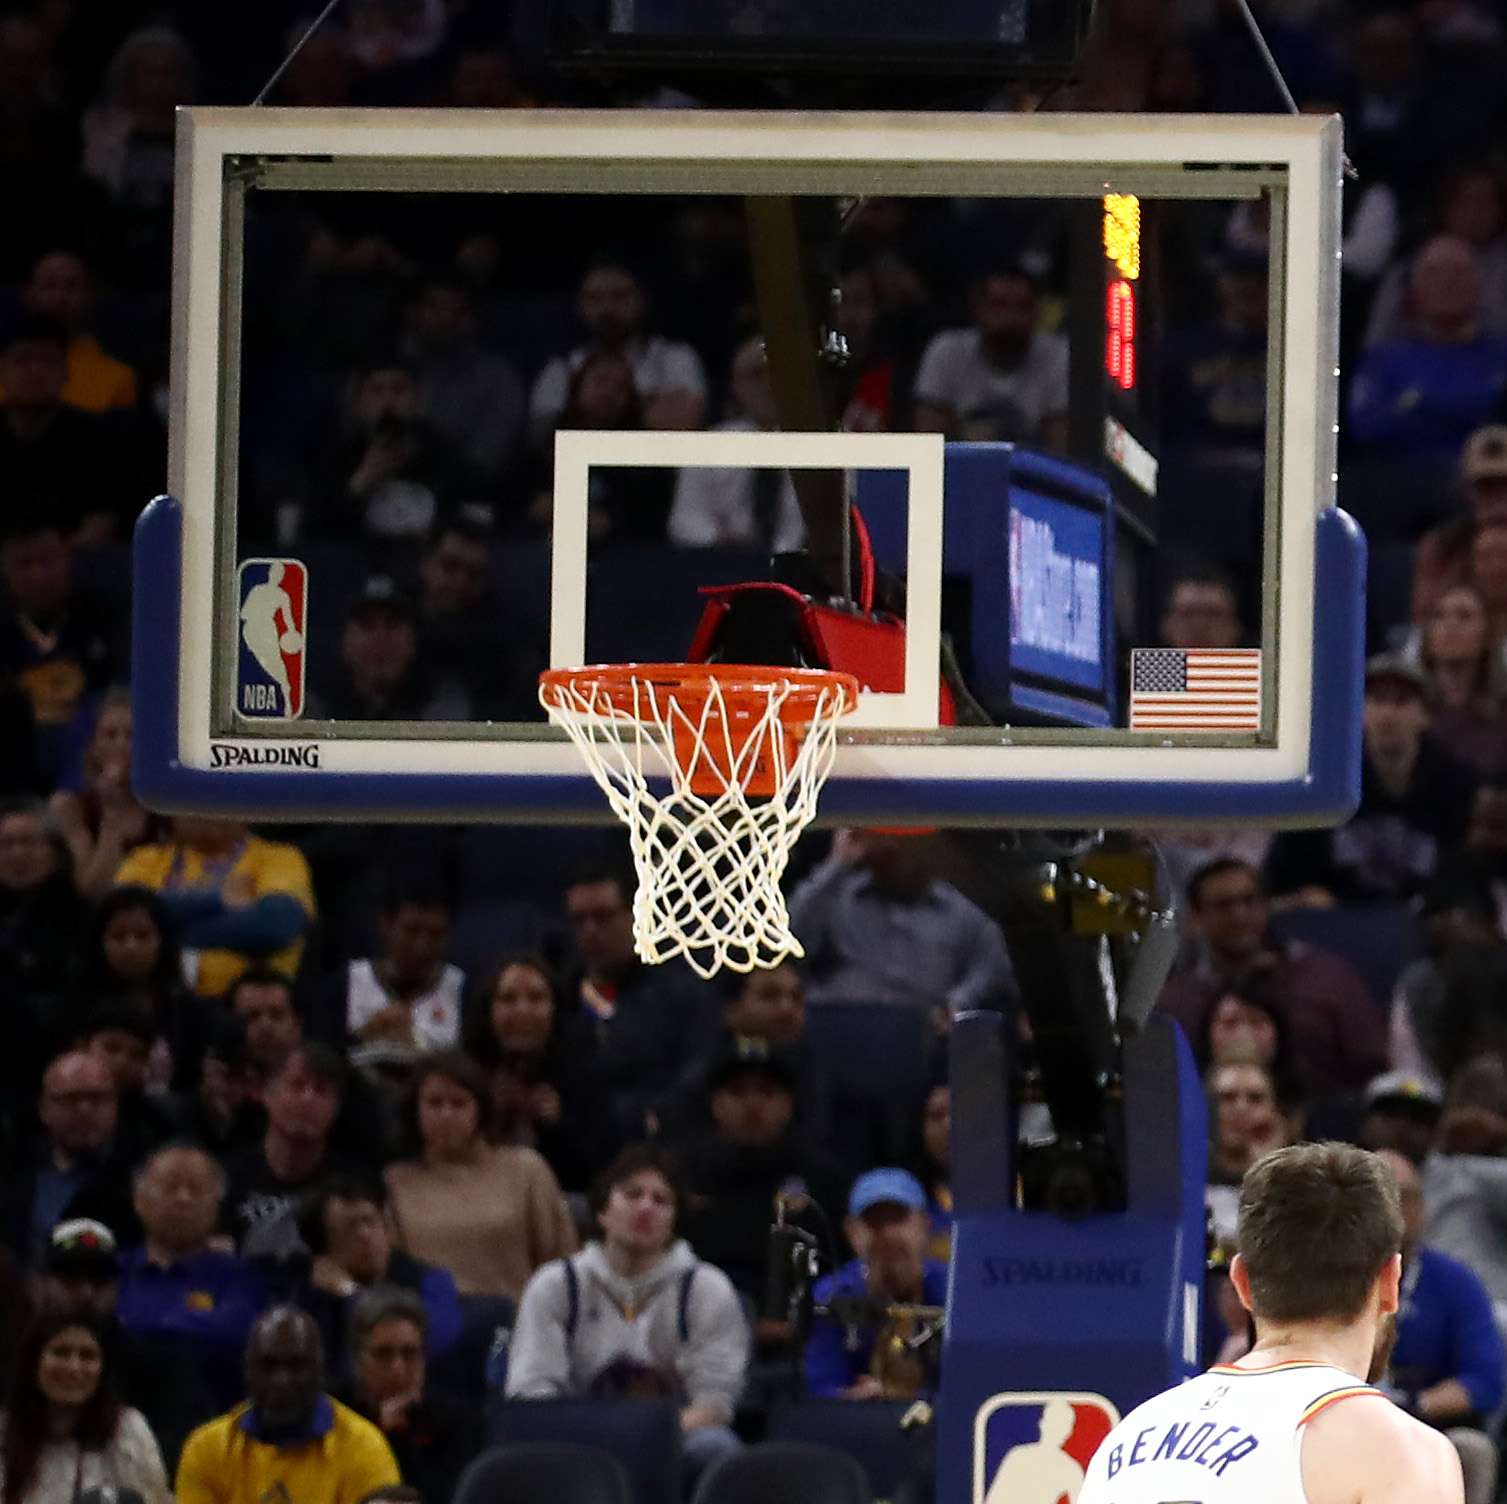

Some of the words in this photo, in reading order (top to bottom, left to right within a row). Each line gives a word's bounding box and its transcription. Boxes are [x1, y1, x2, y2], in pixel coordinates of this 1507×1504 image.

[243, 684, 278, 711] NBA
[210, 743, 320, 769] SPALDING
[1106, 1421, 1260, 1480] BENDER
